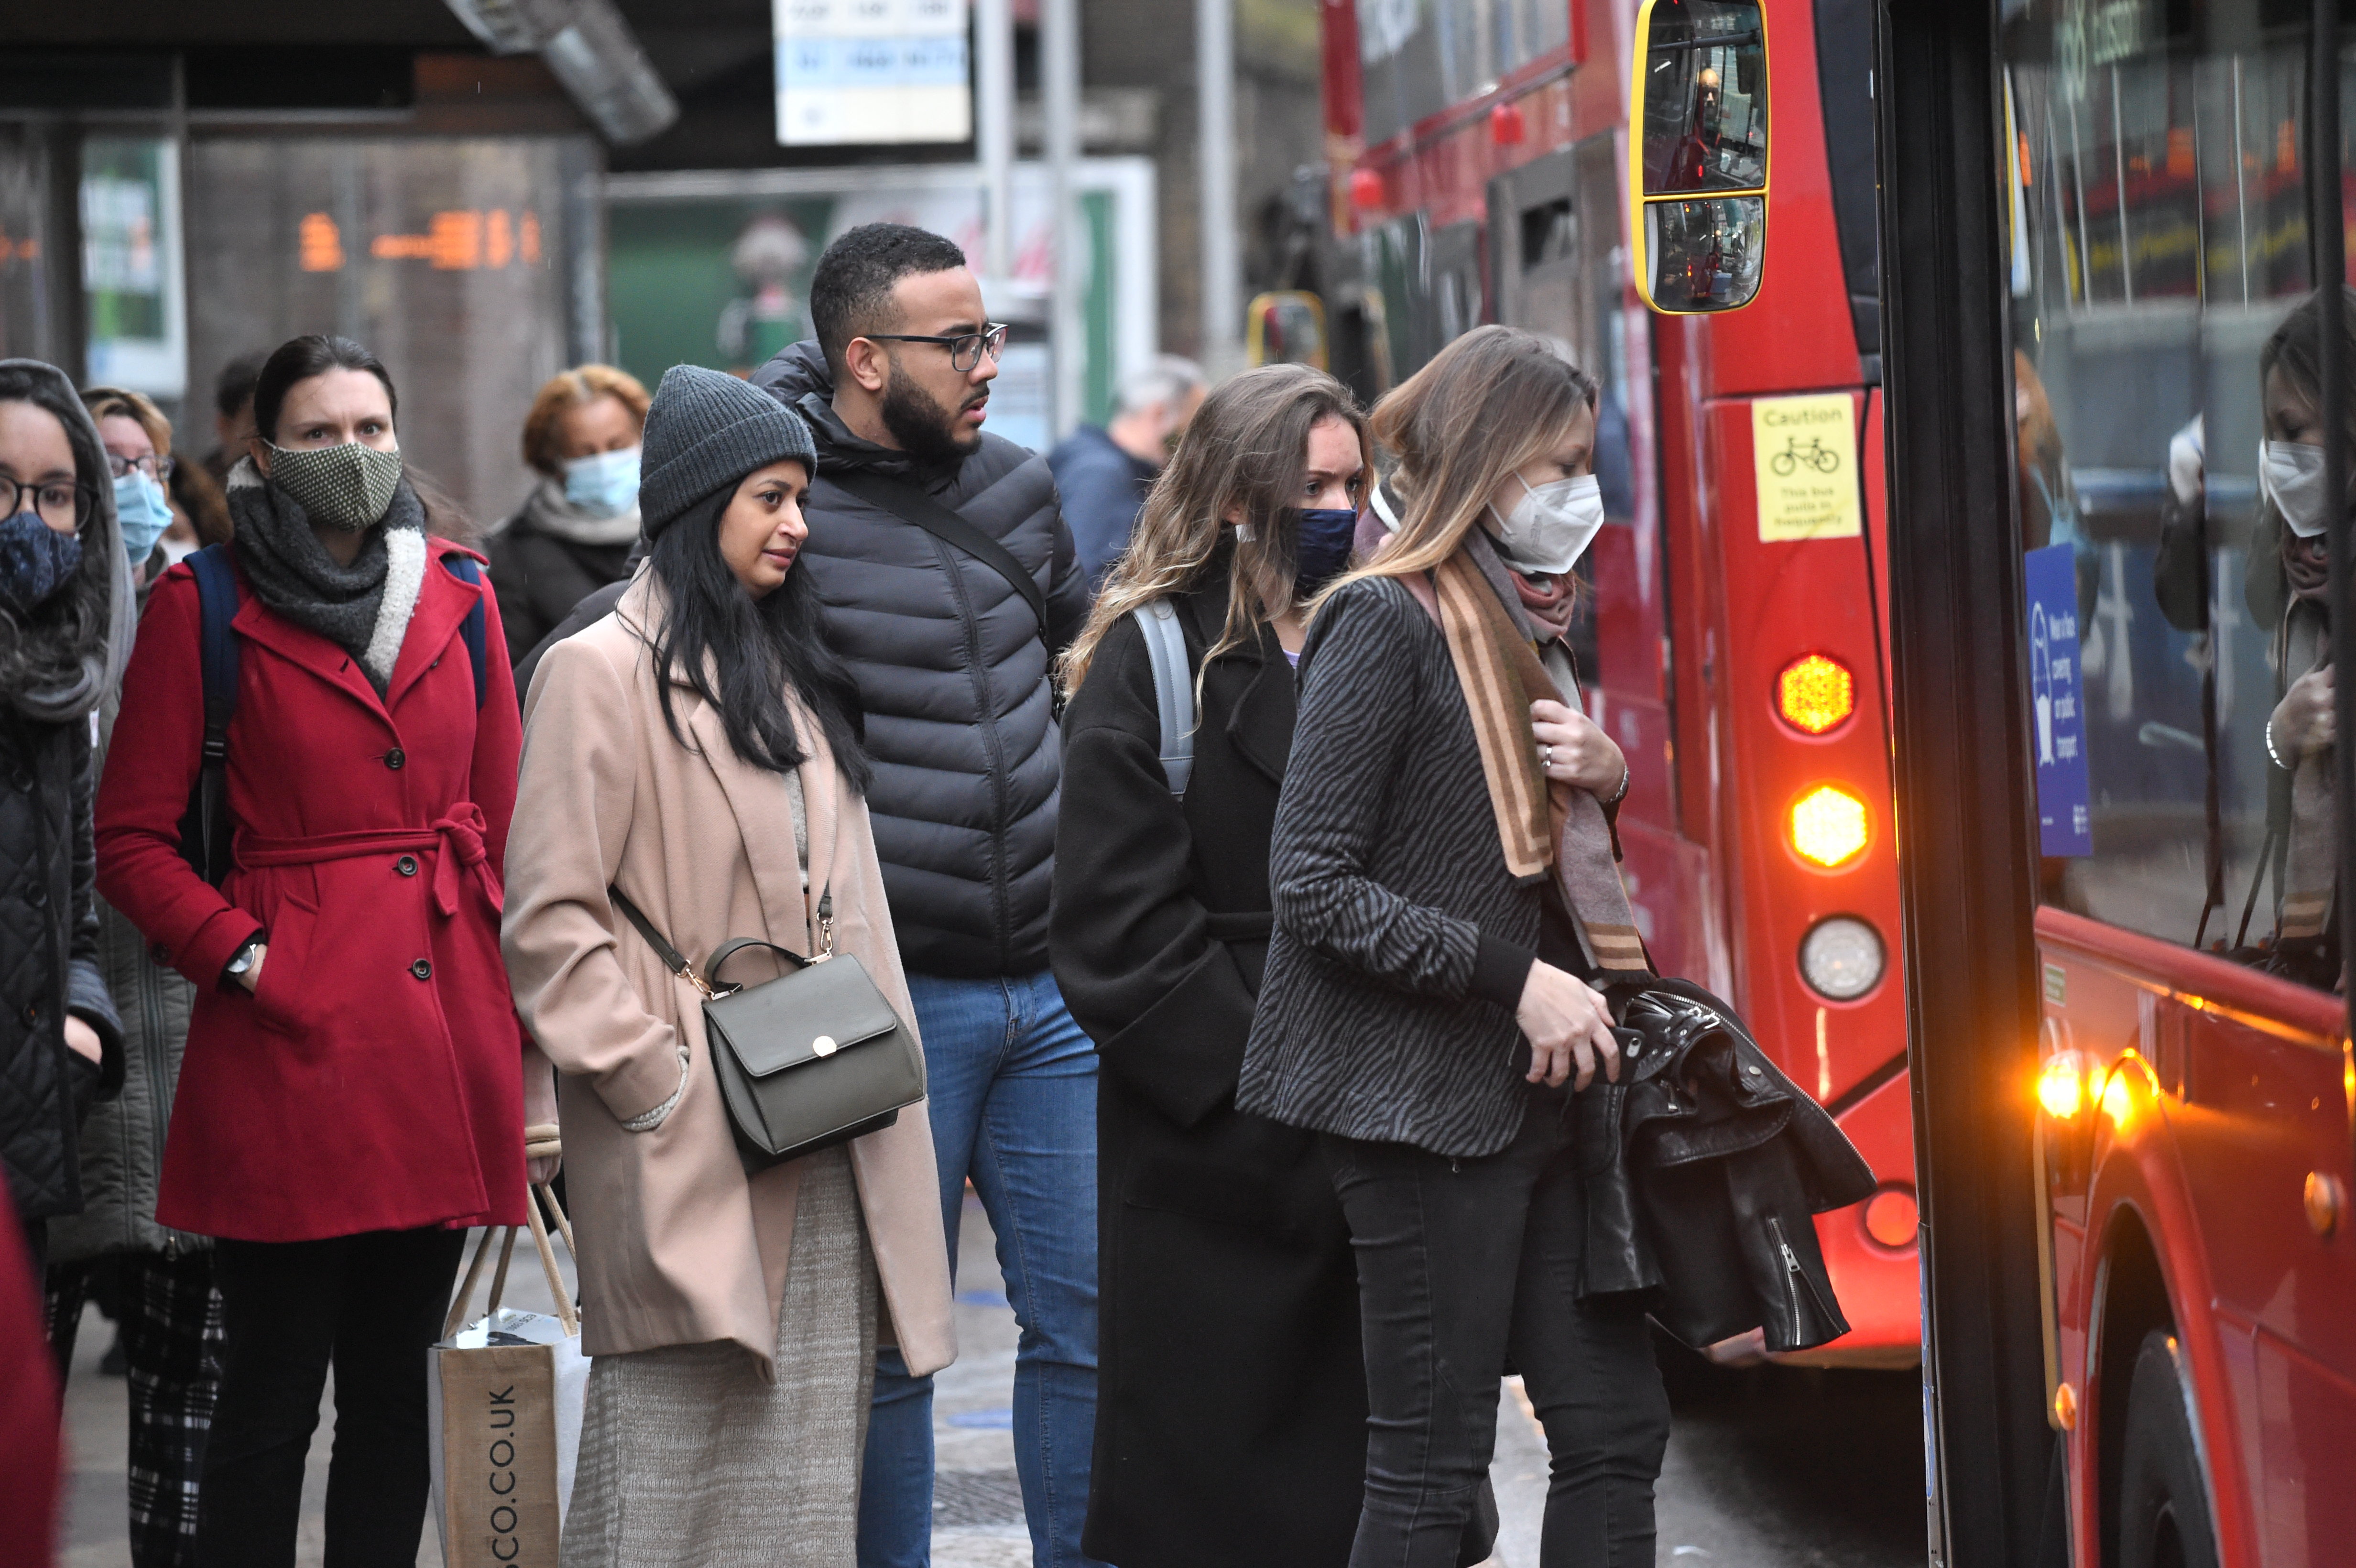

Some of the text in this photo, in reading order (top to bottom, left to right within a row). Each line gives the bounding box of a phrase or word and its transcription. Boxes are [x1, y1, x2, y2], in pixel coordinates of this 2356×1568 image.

[1764, 408, 1842, 426] Caution
[1812, 486, 1833, 496] bus
[489, 1385, 519, 1568] CO.CO.UK
